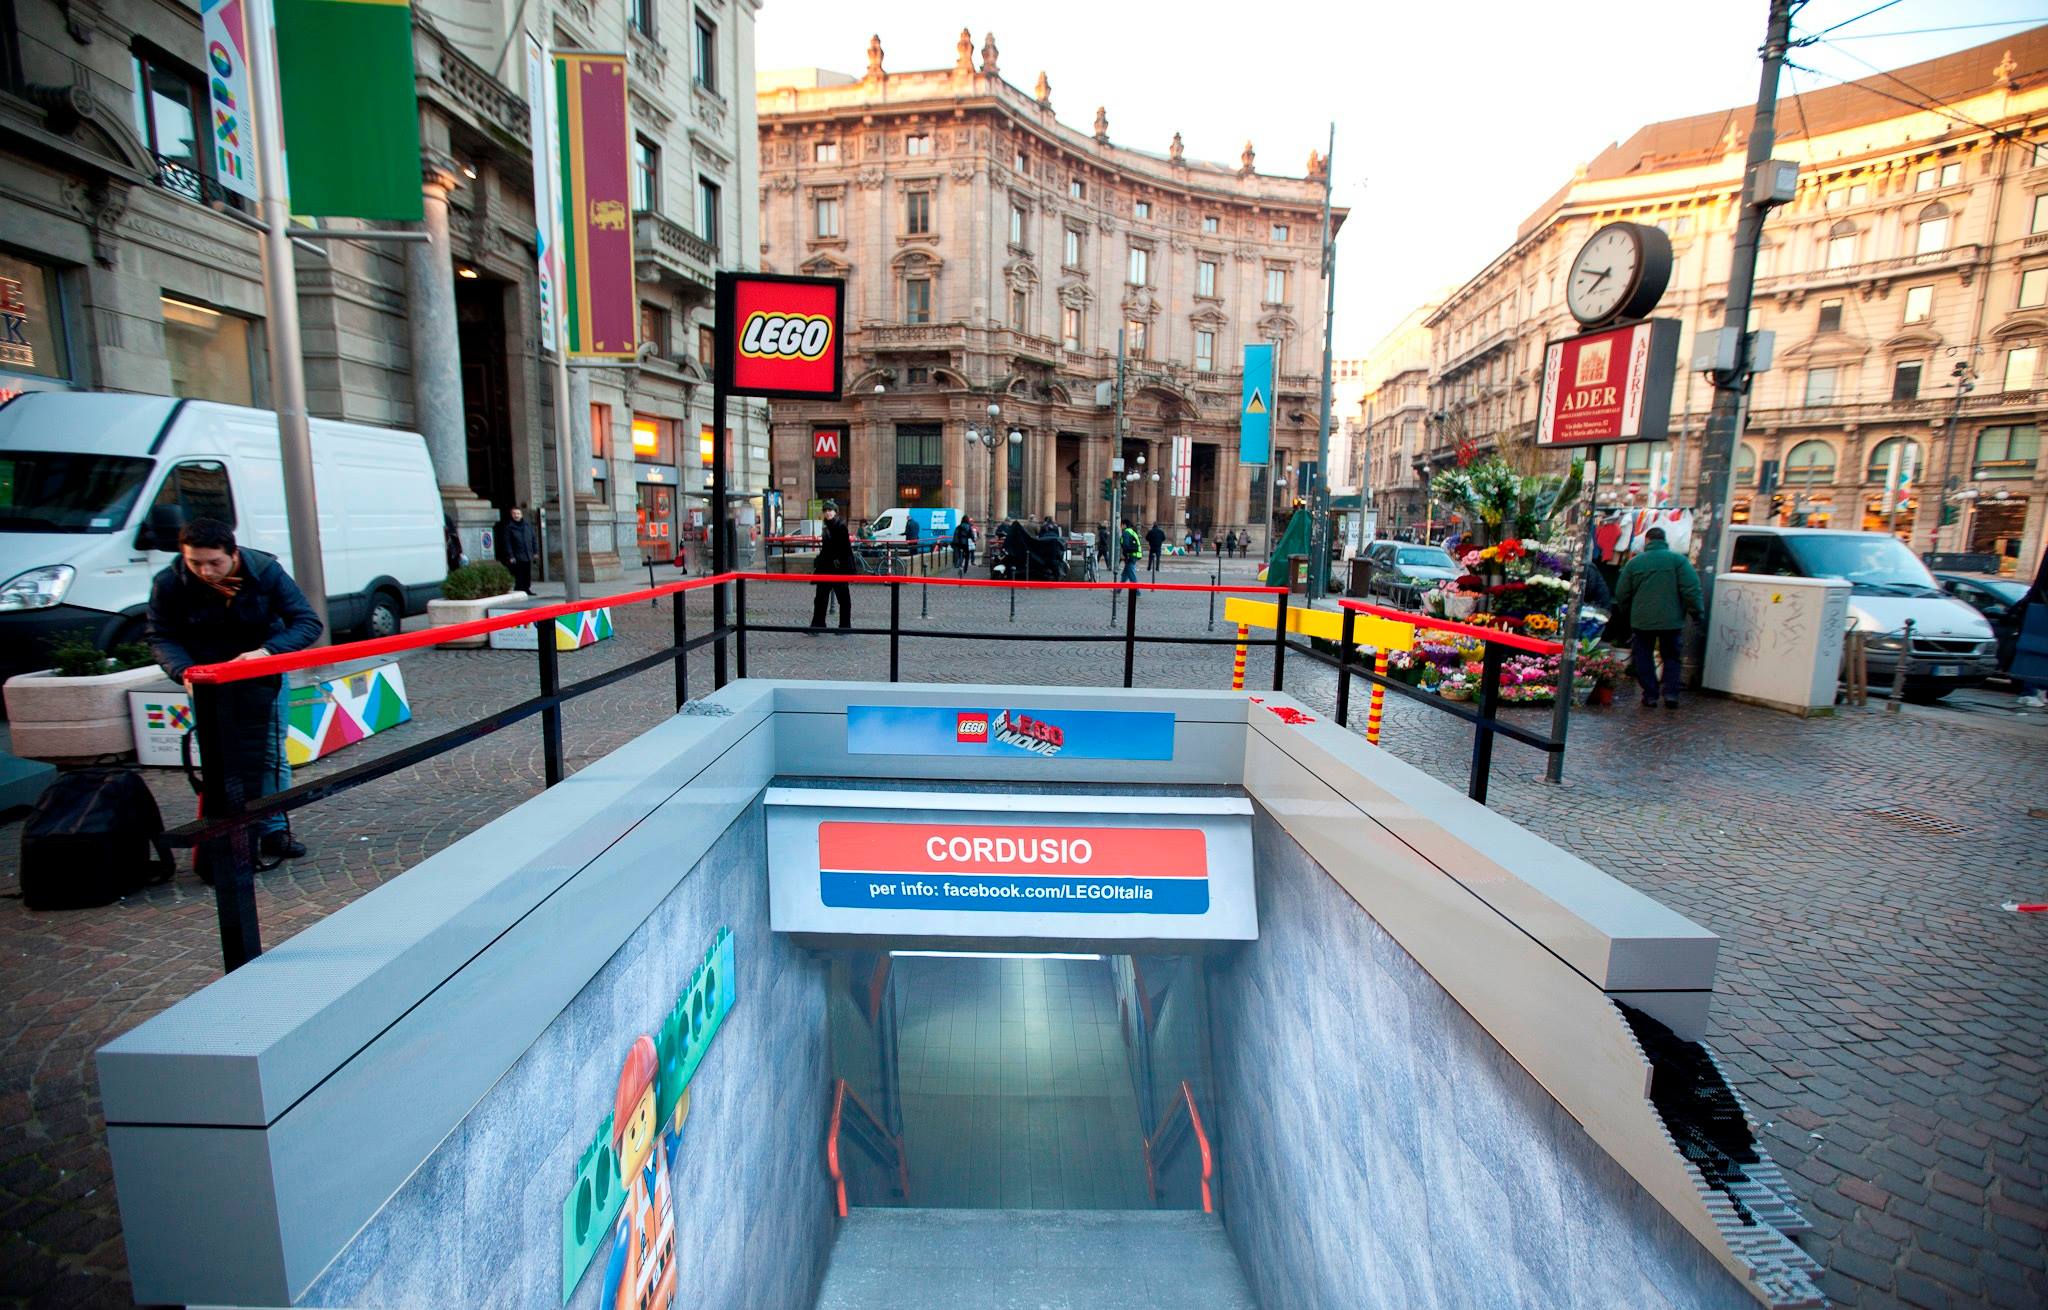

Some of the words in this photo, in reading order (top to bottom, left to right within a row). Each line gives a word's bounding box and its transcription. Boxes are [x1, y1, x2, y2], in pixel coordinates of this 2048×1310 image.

[209, 40, 243, 181] EXPO
[741, 314, 831, 358] LEGO
[1630, 337, 1646, 418] APERTI
[1543, 348, 1558, 440] DOMENICA
[1562, 386, 1616, 411] ADER
[816, 436, 837, 453] M
[144, 703, 192, 731] EX
[959, 721, 987, 734] LEGO
[992, 709, 1008, 732] THE
[1003, 709, 1065, 747] LEGO
[997, 729, 1063, 757] MOVIE
[926, 836, 1093, 864] CORDUSIO
[869, 884, 897, 898] per
[901, 881, 939, 896] info:
[943, 882, 1153, 900] facebook.com/LEGOItalia
